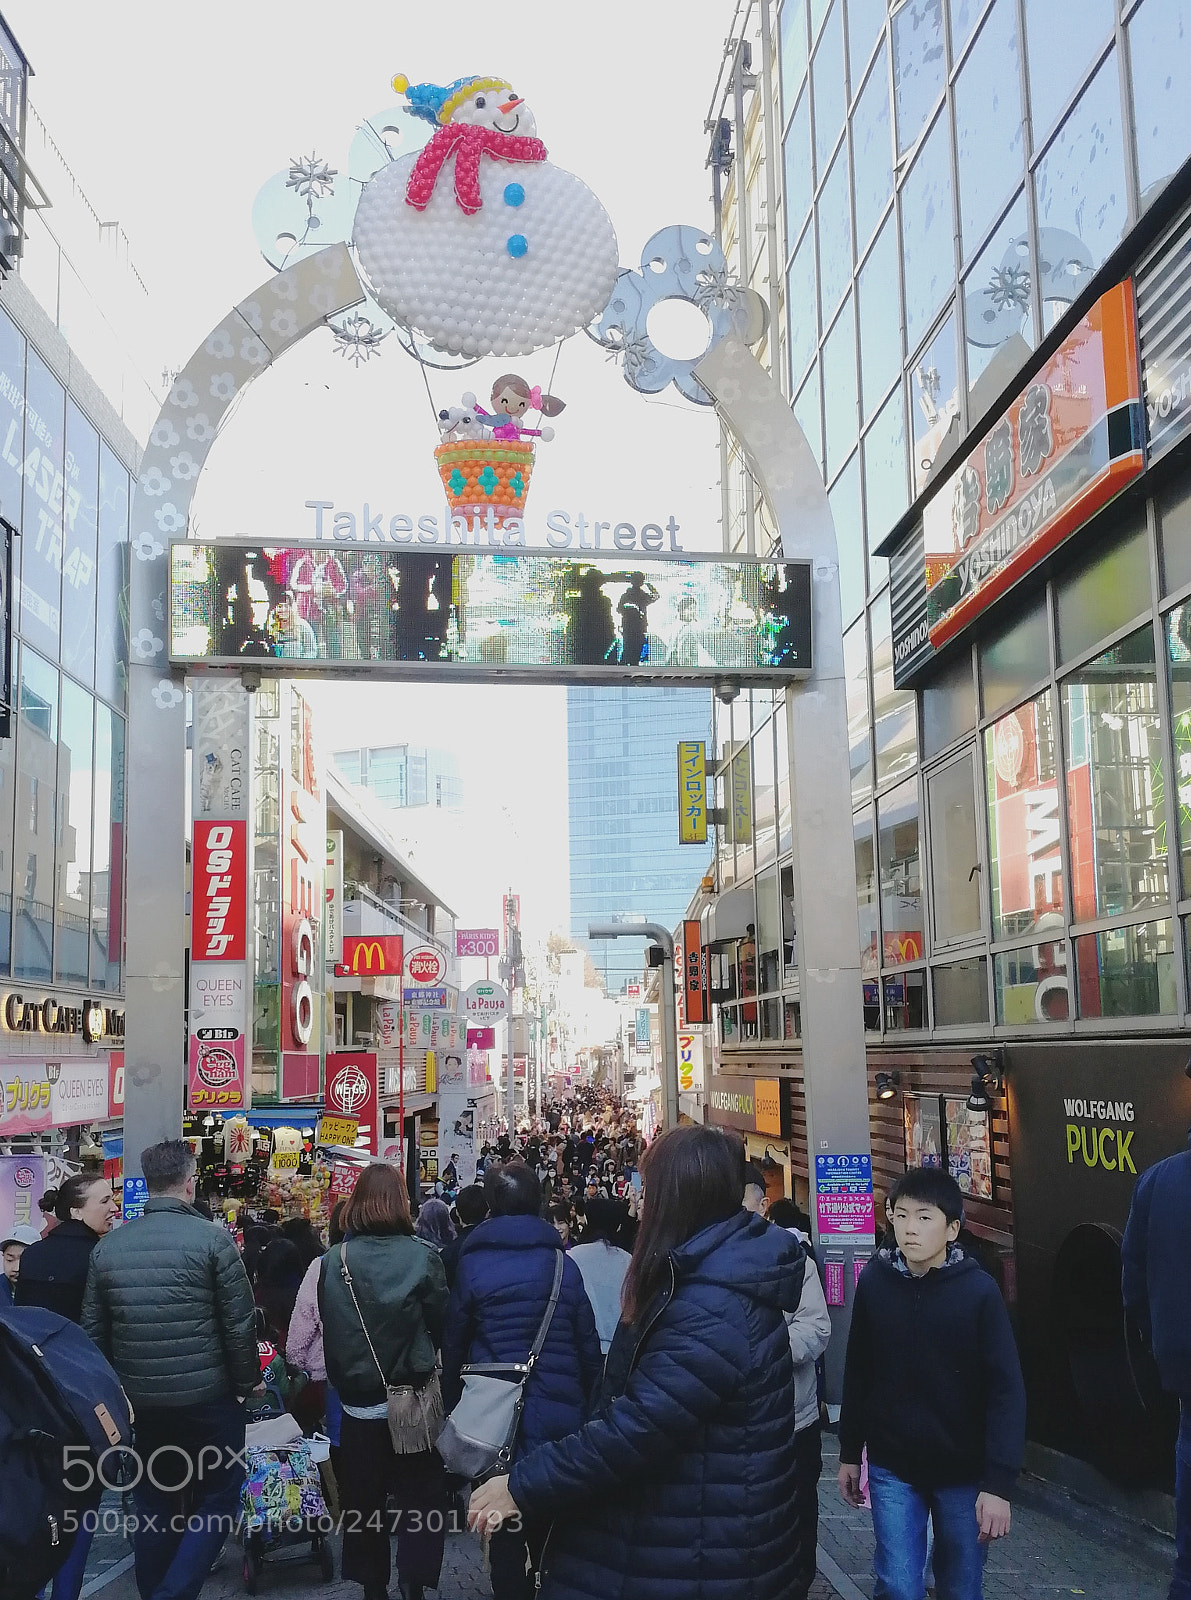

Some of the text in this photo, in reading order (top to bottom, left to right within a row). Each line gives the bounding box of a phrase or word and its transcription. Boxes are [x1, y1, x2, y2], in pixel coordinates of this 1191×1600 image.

[1, 418, 81, 532] LASER
[305, 500, 683, 551] Takeshita Street
[35, 508, 95, 590] TRAP
[230, 748, 242, 811] CAT CAFE
[684, 743, 703, 830] コインロッカー
[205, 825, 233, 957] OSドラッグ
[411, 960, 438, 974] 消火栓
[460, 941, 496, 956] ¥300
[197, 980, 242, 991] QUEEN
[203, 995, 234, 1006] EYES
[466, 998, 505, 1010] La Pausa
[679, 1035, 695, 1090] プリクラ
[58, 1078, 104, 1099] QUEEN EYES
[1064, 1098, 1136, 1122] WOLFGANG
[320, 1133, 355, 1145] HAPPY ONE
[1066, 1124, 1138, 1175] PUCK
